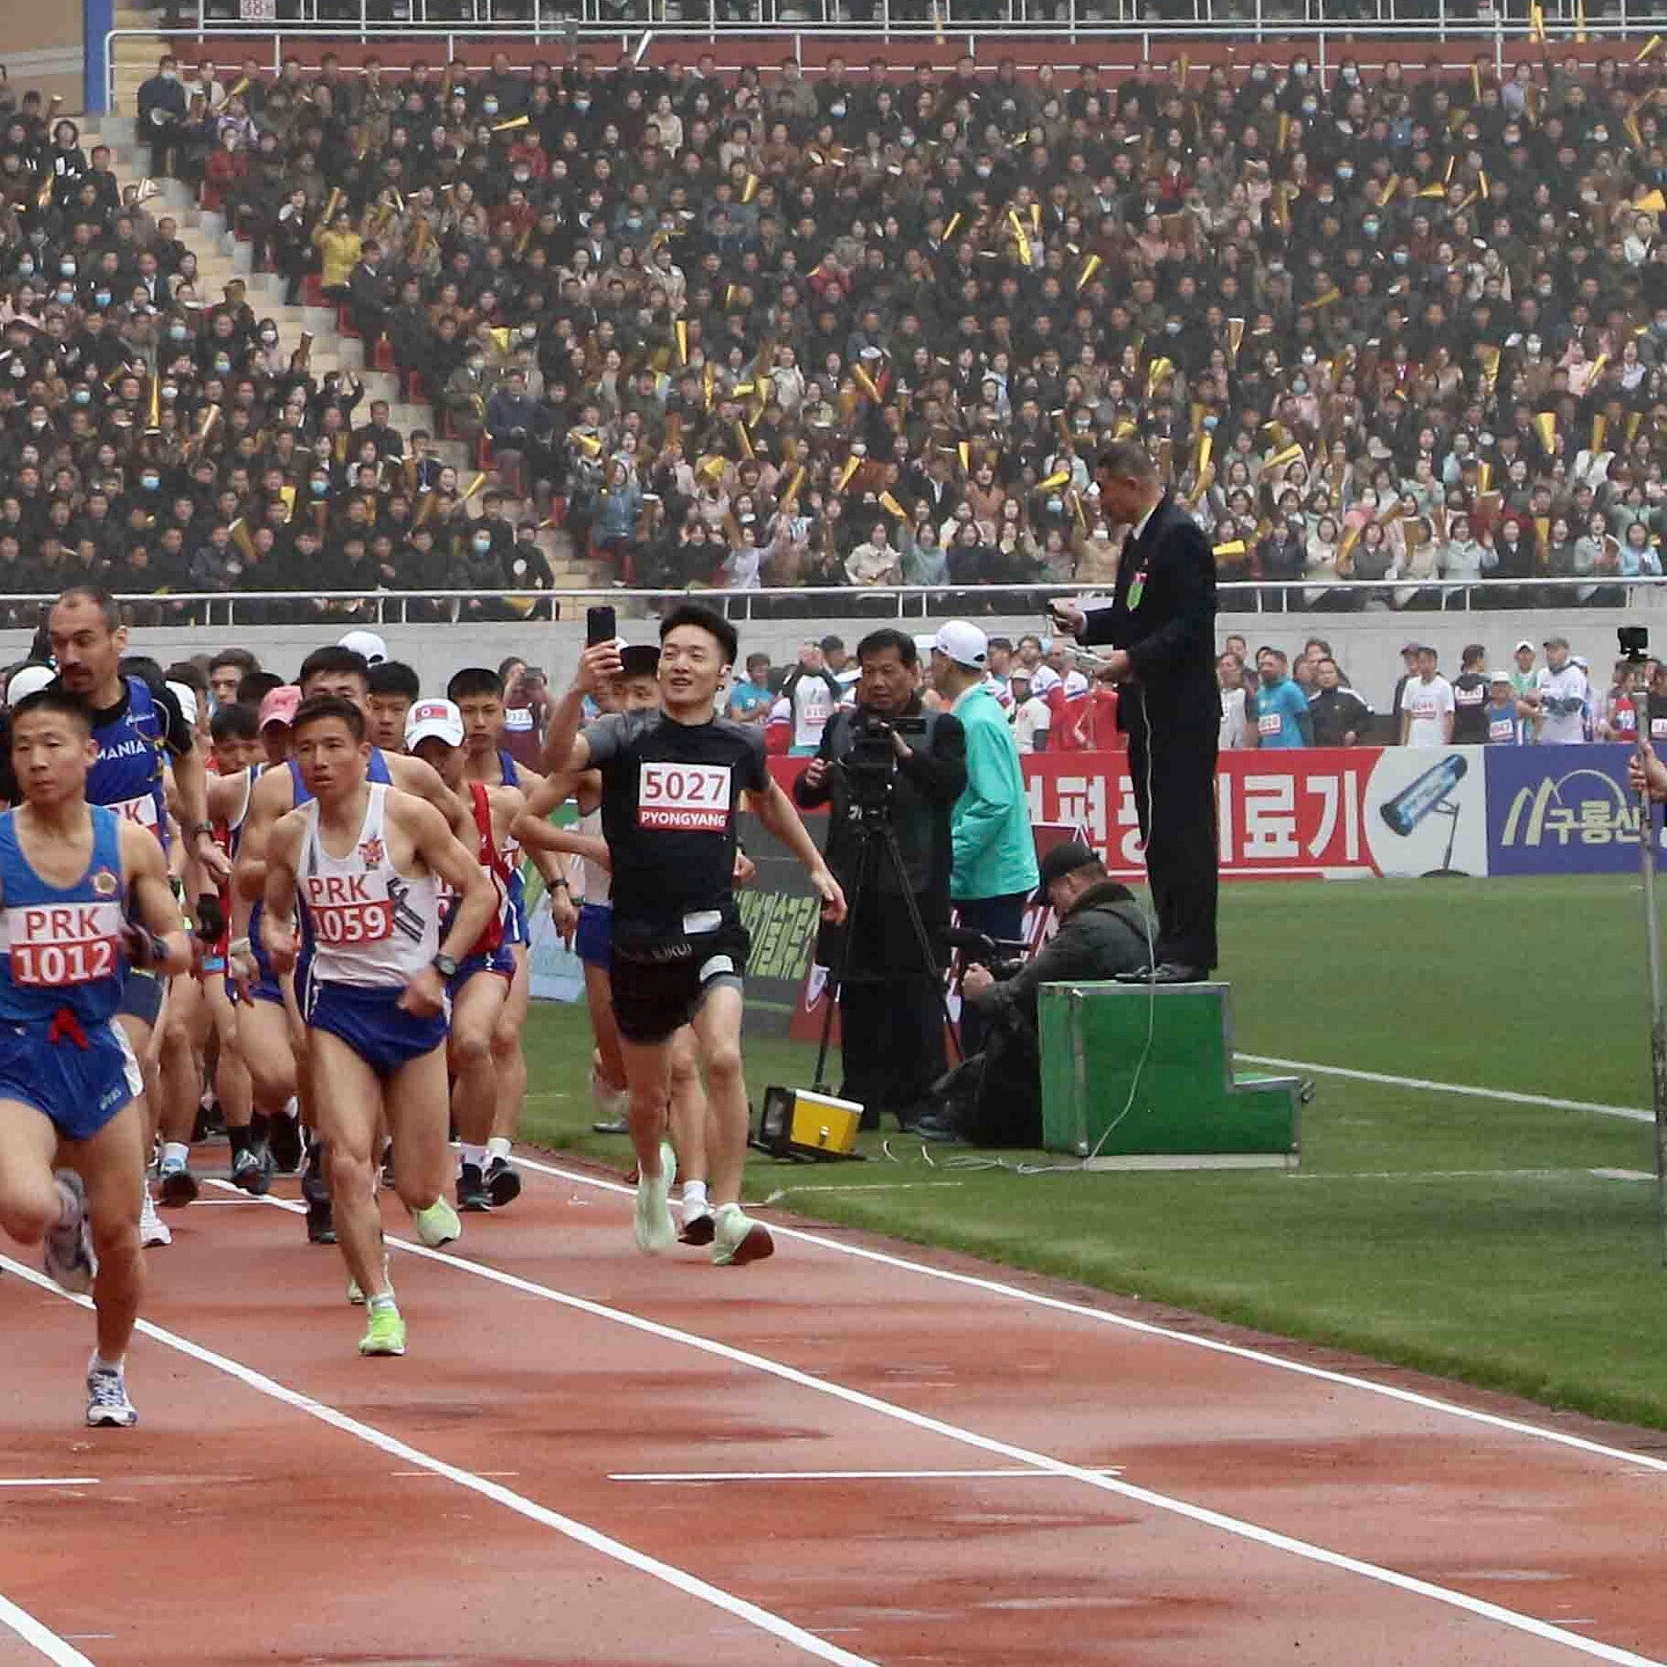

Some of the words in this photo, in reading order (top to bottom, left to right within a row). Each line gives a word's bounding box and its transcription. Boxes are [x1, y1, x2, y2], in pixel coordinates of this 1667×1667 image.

[644, 771, 726, 802] 5027
[640, 811, 727, 828] PYONGYANG
[308, 874, 371, 904] PRK
[25, 906, 103, 941] PRK
[16, 940, 112, 985] 1012
